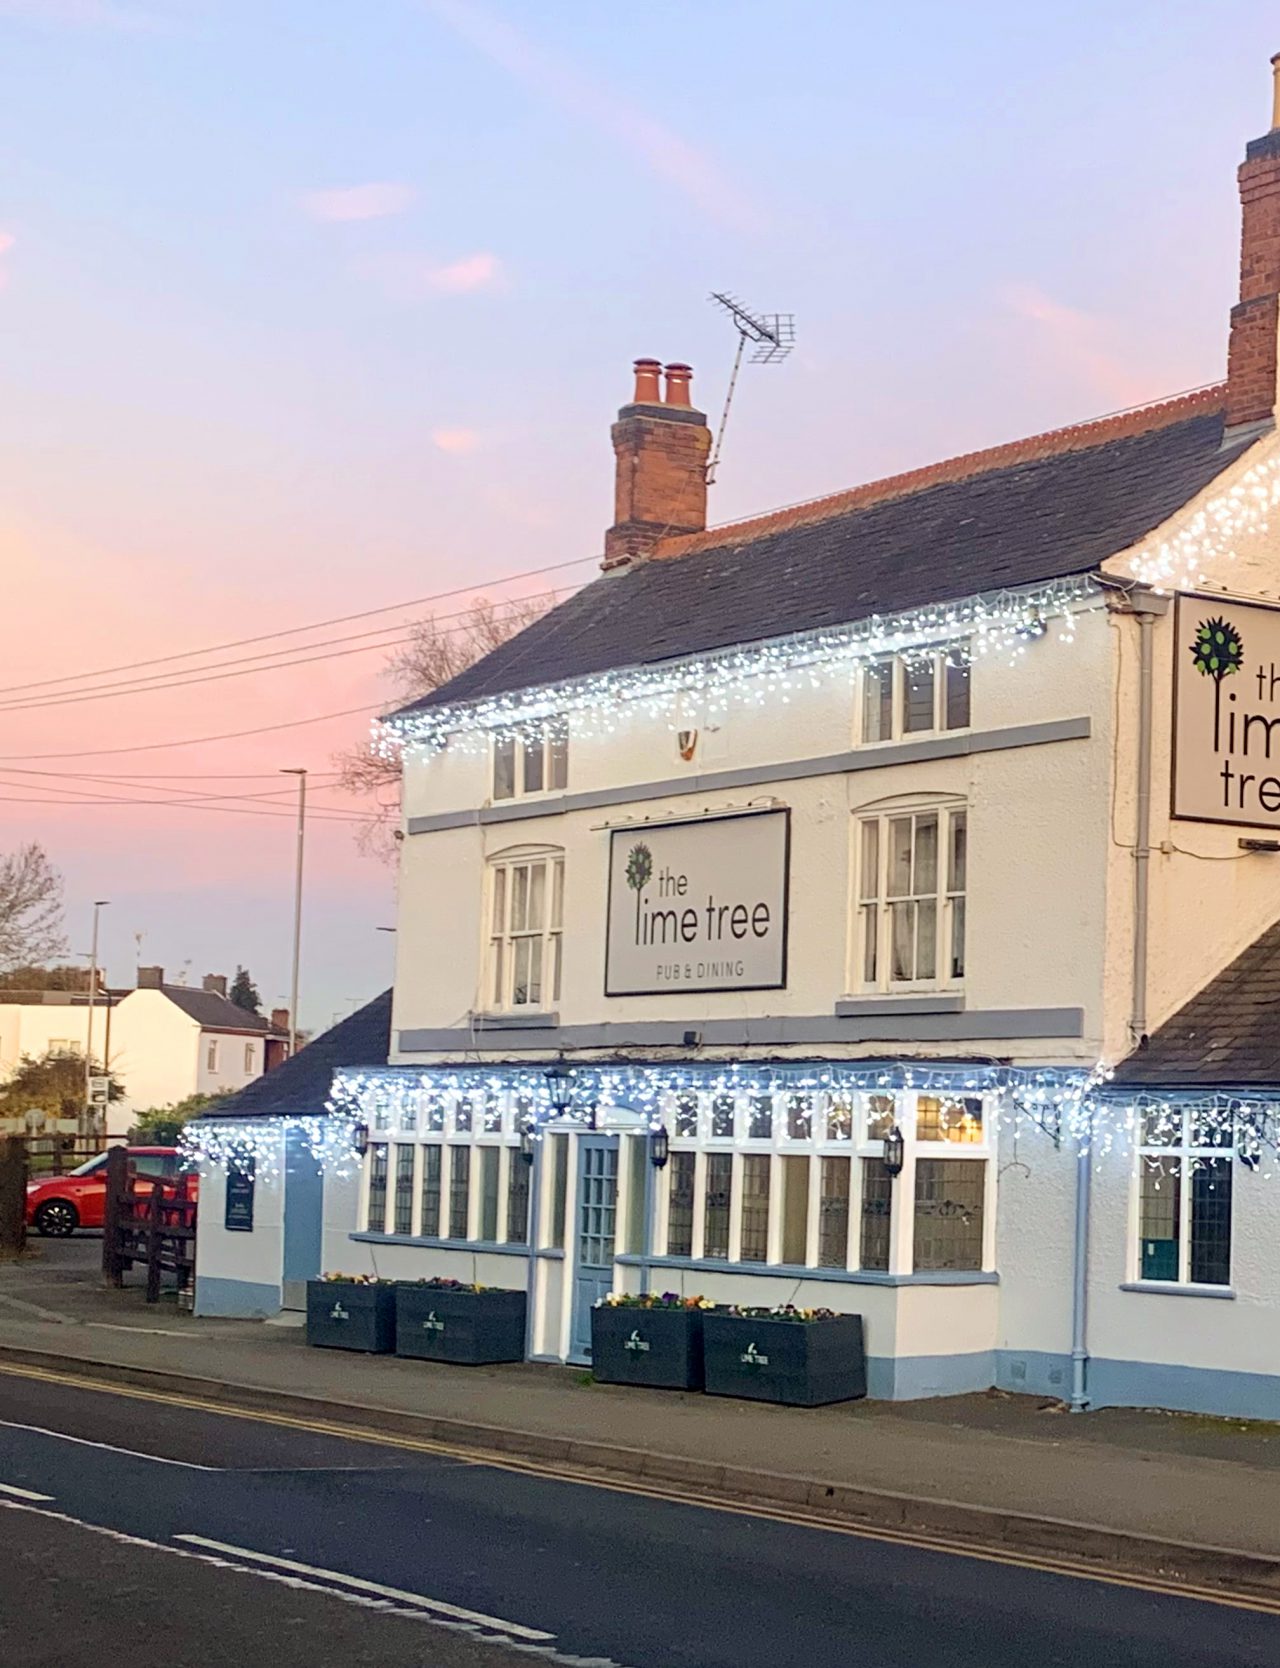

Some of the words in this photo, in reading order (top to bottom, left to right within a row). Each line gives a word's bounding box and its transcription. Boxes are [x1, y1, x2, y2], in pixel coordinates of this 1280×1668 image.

[658, 867, 688, 897] the
[635, 893, 698, 945] lime
[706, 895, 770, 940] tree
[656, 964, 680, 980] PUB
[684, 963, 692, 979] &
[697, 960, 744, 978] DINING
